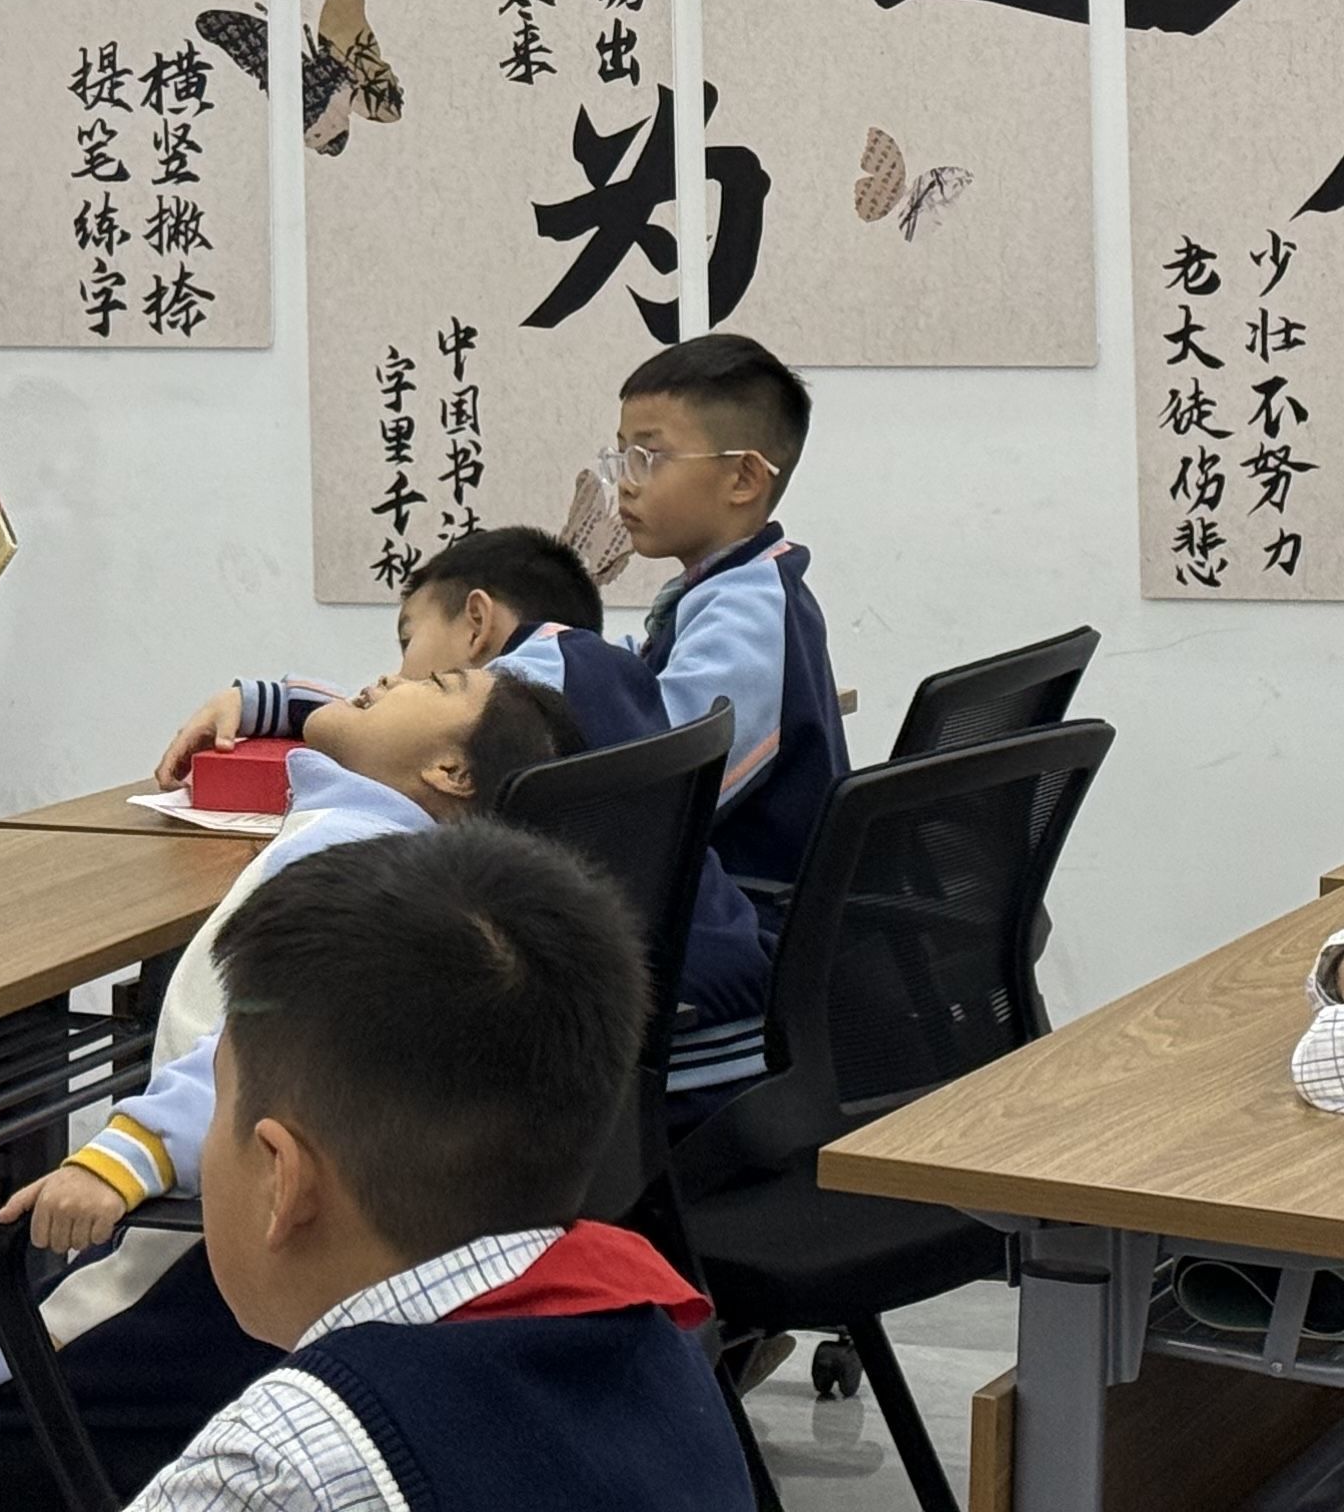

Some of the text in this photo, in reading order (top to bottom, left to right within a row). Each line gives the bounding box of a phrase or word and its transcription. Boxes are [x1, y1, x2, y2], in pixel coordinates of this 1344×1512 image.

[67, 40, 134, 338] 提笔练字
[137, 38, 216, 338] 横竖撇捺
[1160, 235, 1235, 588] 老大徒伤悲
[1239, 229, 1320, 577] 少壮不努力
